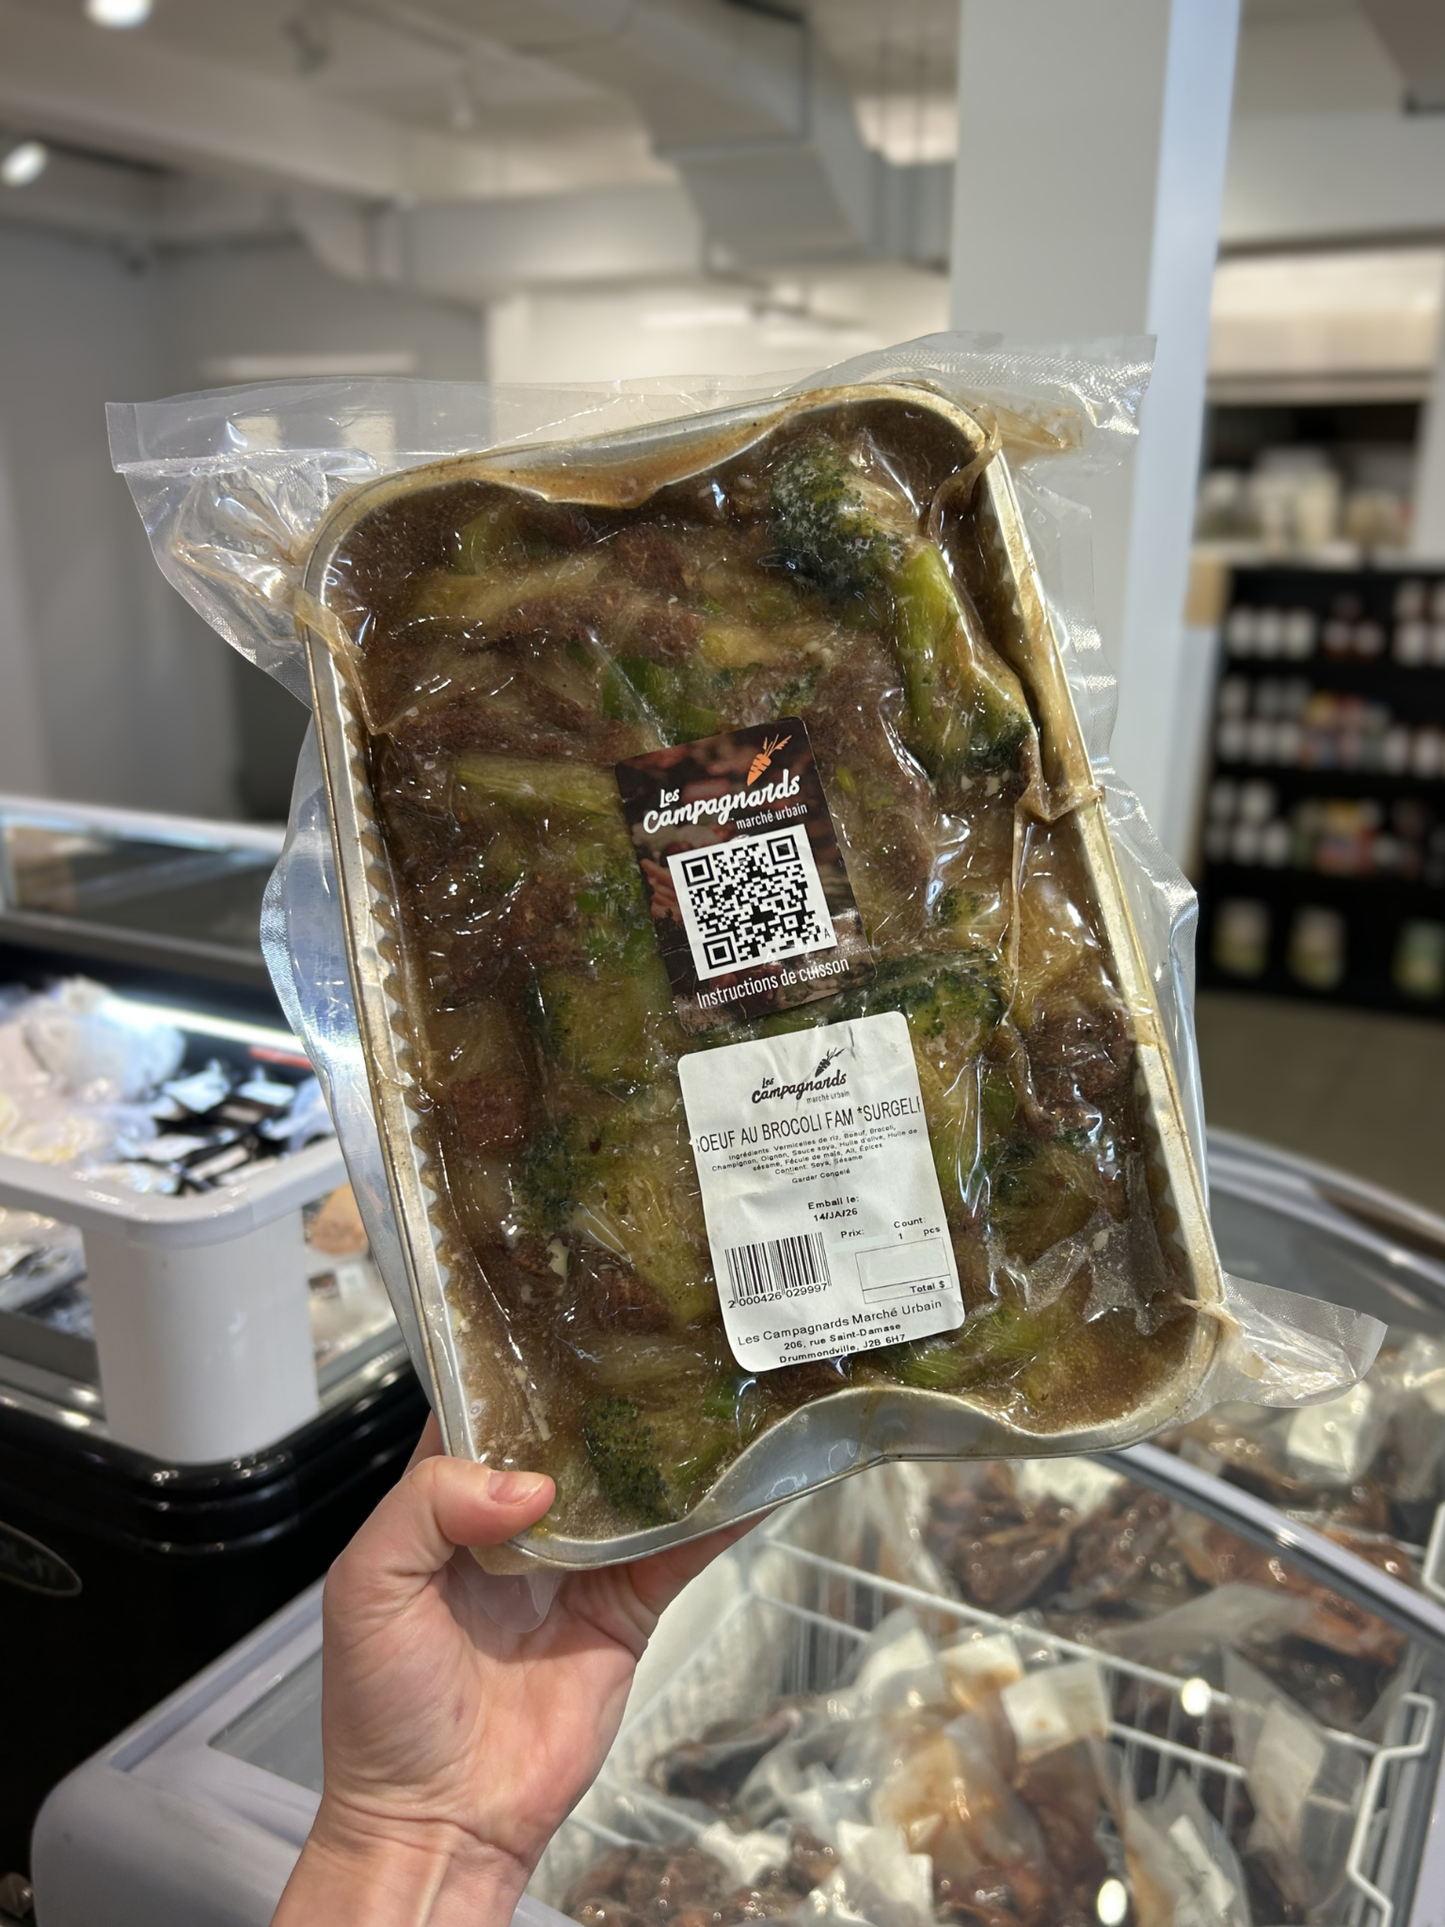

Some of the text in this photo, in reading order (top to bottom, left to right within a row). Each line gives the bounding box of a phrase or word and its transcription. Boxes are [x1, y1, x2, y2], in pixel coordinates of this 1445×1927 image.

[643, 768, 800, 834] Campagnards
[659, 788, 680, 808] Les
[736, 803, 808, 830] marché urbain
[696, 958, 850, 1009] Instructions de cuisson
[751, 1069, 847, 1104] Campagnards
[761, 1076, 775, 1089] Les
[806, 1090, 850, 1104] marché urbain
[696, 1130, 735, 1152] OEUF
[741, 1125, 758, 1146] AU
[761, 1113, 822, 1141] BROCOLI
[825, 1108, 854, 1129] FAM
[773, 1139, 816, 1152] Vermicelles
[711, 1158, 759, 1172] Champignon,
[760, 1152, 790, 1162] Oignon,
[791, 1147, 815, 1156] Sauce
[785, 1155, 810, 1165] Fécule
[791, 1168, 851, 1184] Garder Congelé
[808, 1195, 859, 1211] Emball le:
[813, 1207, 858, 1222] 14/JA/26
[893, 1216, 926, 1229] Count:
[841, 1228, 865, 1239] Prix:
[923, 1226, 941, 1237] pcs
[910, 1280, 946, 1294] Total $
[737, 1300, 942, 1346] Les Campagnards Marché Urbain
[783, 1322, 901, 1351] 206, rue Saint-Damase
[779, 1333, 905, 1364] Drummondville, J2B 6H7
